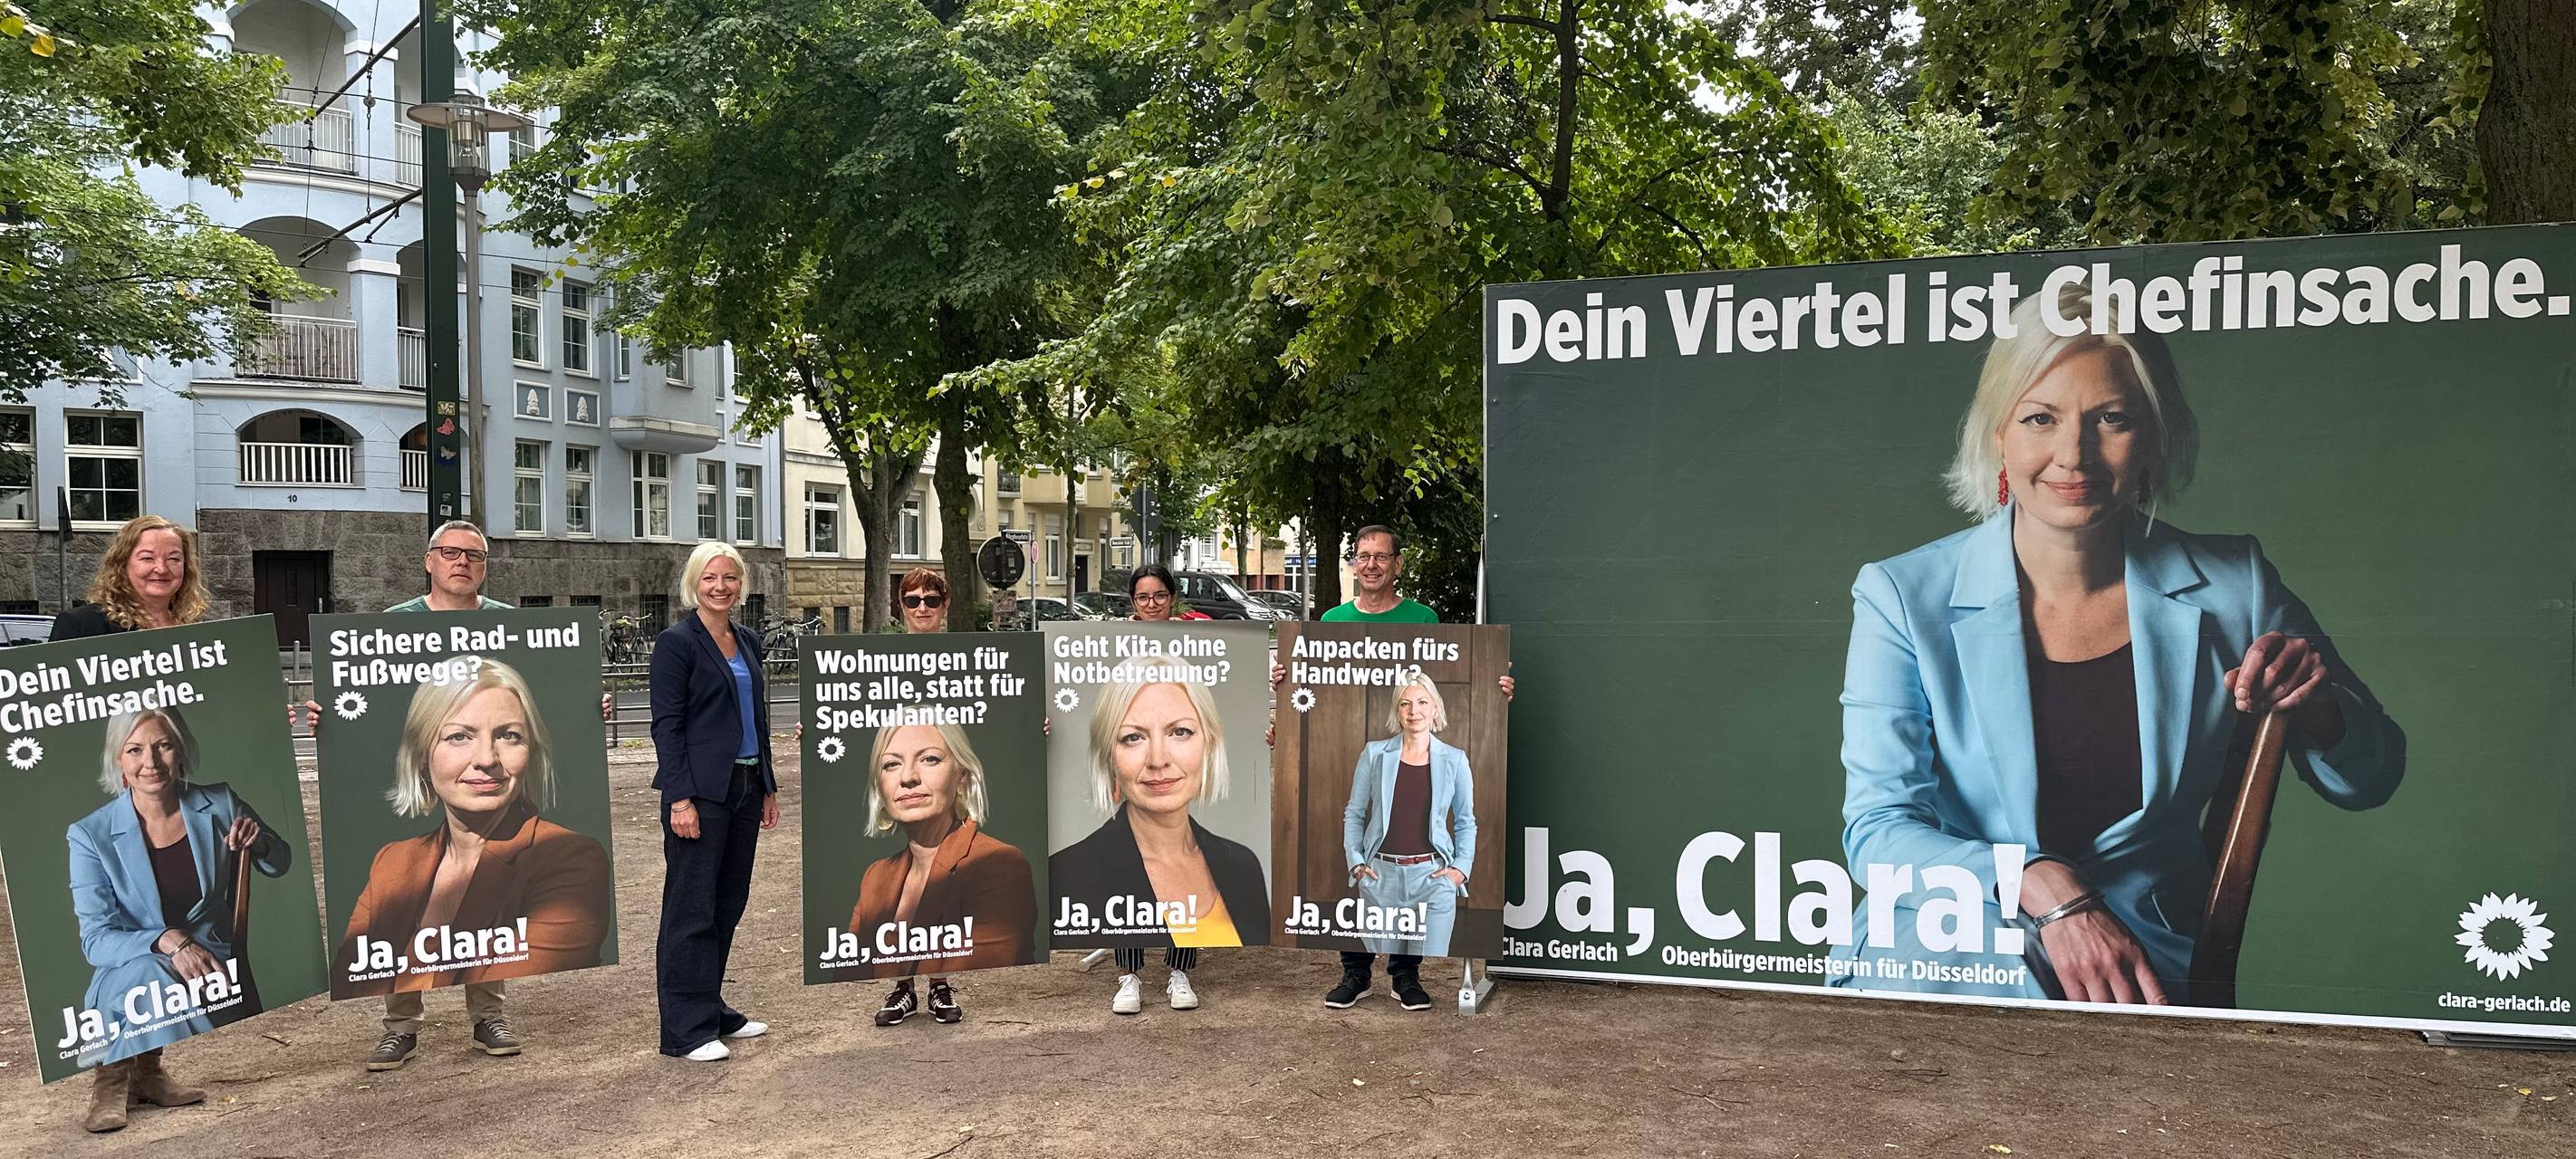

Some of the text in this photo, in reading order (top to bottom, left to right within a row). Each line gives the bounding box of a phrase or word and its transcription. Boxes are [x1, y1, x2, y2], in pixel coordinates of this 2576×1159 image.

[1497, 244, 2571, 364] Dein Viertel ist Chefinsache.
[287, 494, 298, 503] 10
[330, 621, 581, 656] Sichere Rad- und
[1053, 634, 1226, 658] Geht Kita ohne
[1291, 635, 1459, 662] Anpacken fürs
[0, 639, 227, 699] Dein Viertel ist
[332, 656, 483, 687] Fußwege?
[814, 647, 1009, 675] Wohnungen für
[1053, 660, 1231, 686] Notbetreuung?
[1291, 662, 1422, 686] Handwerk?
[815, 673, 1025, 704] uns alle, statt für
[0, 679, 205, 733] Chefinsache.
[815, 701, 987, 733] Spekulanten?
[1504, 827, 2027, 957] Ja, Clara!
[1053, 894, 1197, 934] Ja, Clara!
[1284, 896, 1428, 934] Ja, Clara!
[348, 916, 529, 974] Ja, Clara!
[819, 915, 974, 963] Ja, Clara!
[1397, 933, 1427, 942] Düsseldorf
[348, 953, 529, 982] Clara Gerlach Oberbürgermeisterin für Düsseldorf
[836, 959, 859, 968] Gerlach
[871, 953, 932, 965] Oberbürgermeisterin
[933, 952, 942, 960] für
[1548, 939, 1618, 963] Gerlach
[1661, 943, 1871, 979] Oberbürgermeisterin
[1876, 955, 1908, 980] für
[1911, 959, 2027, 986] Düsseldorf
[58, 957, 242, 1049] Ja, Clara!
[2437, 991, 2571, 1013] clara-gerlach.de
[59, 995, 243, 1059] Clara Gerlach Oberbürgermeisterin für Düsseldorf
